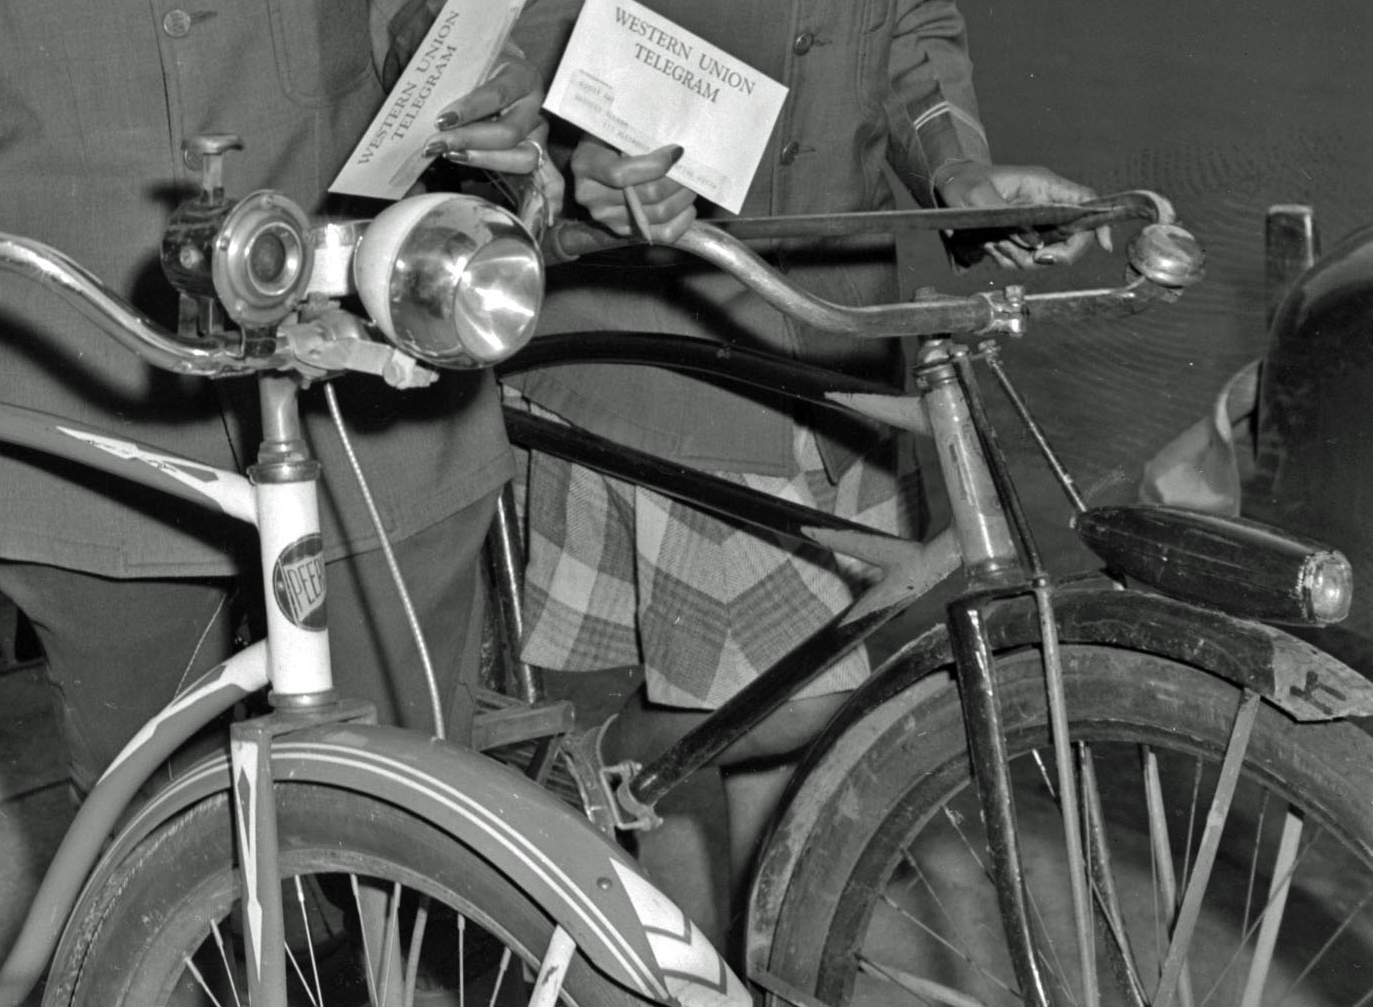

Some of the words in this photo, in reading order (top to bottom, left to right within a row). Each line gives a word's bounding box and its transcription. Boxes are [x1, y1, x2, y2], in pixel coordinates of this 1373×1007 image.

[357, 81, 418, 166] WESTERN
[416, 10, 460, 73] UNION
[391, 44, 458, 142] TELEGRAM
[615, 6, 693, 61] WESTERN
[698, 53, 756, 96] UNION
[635, 43, 720, 103] TELEGRAM
